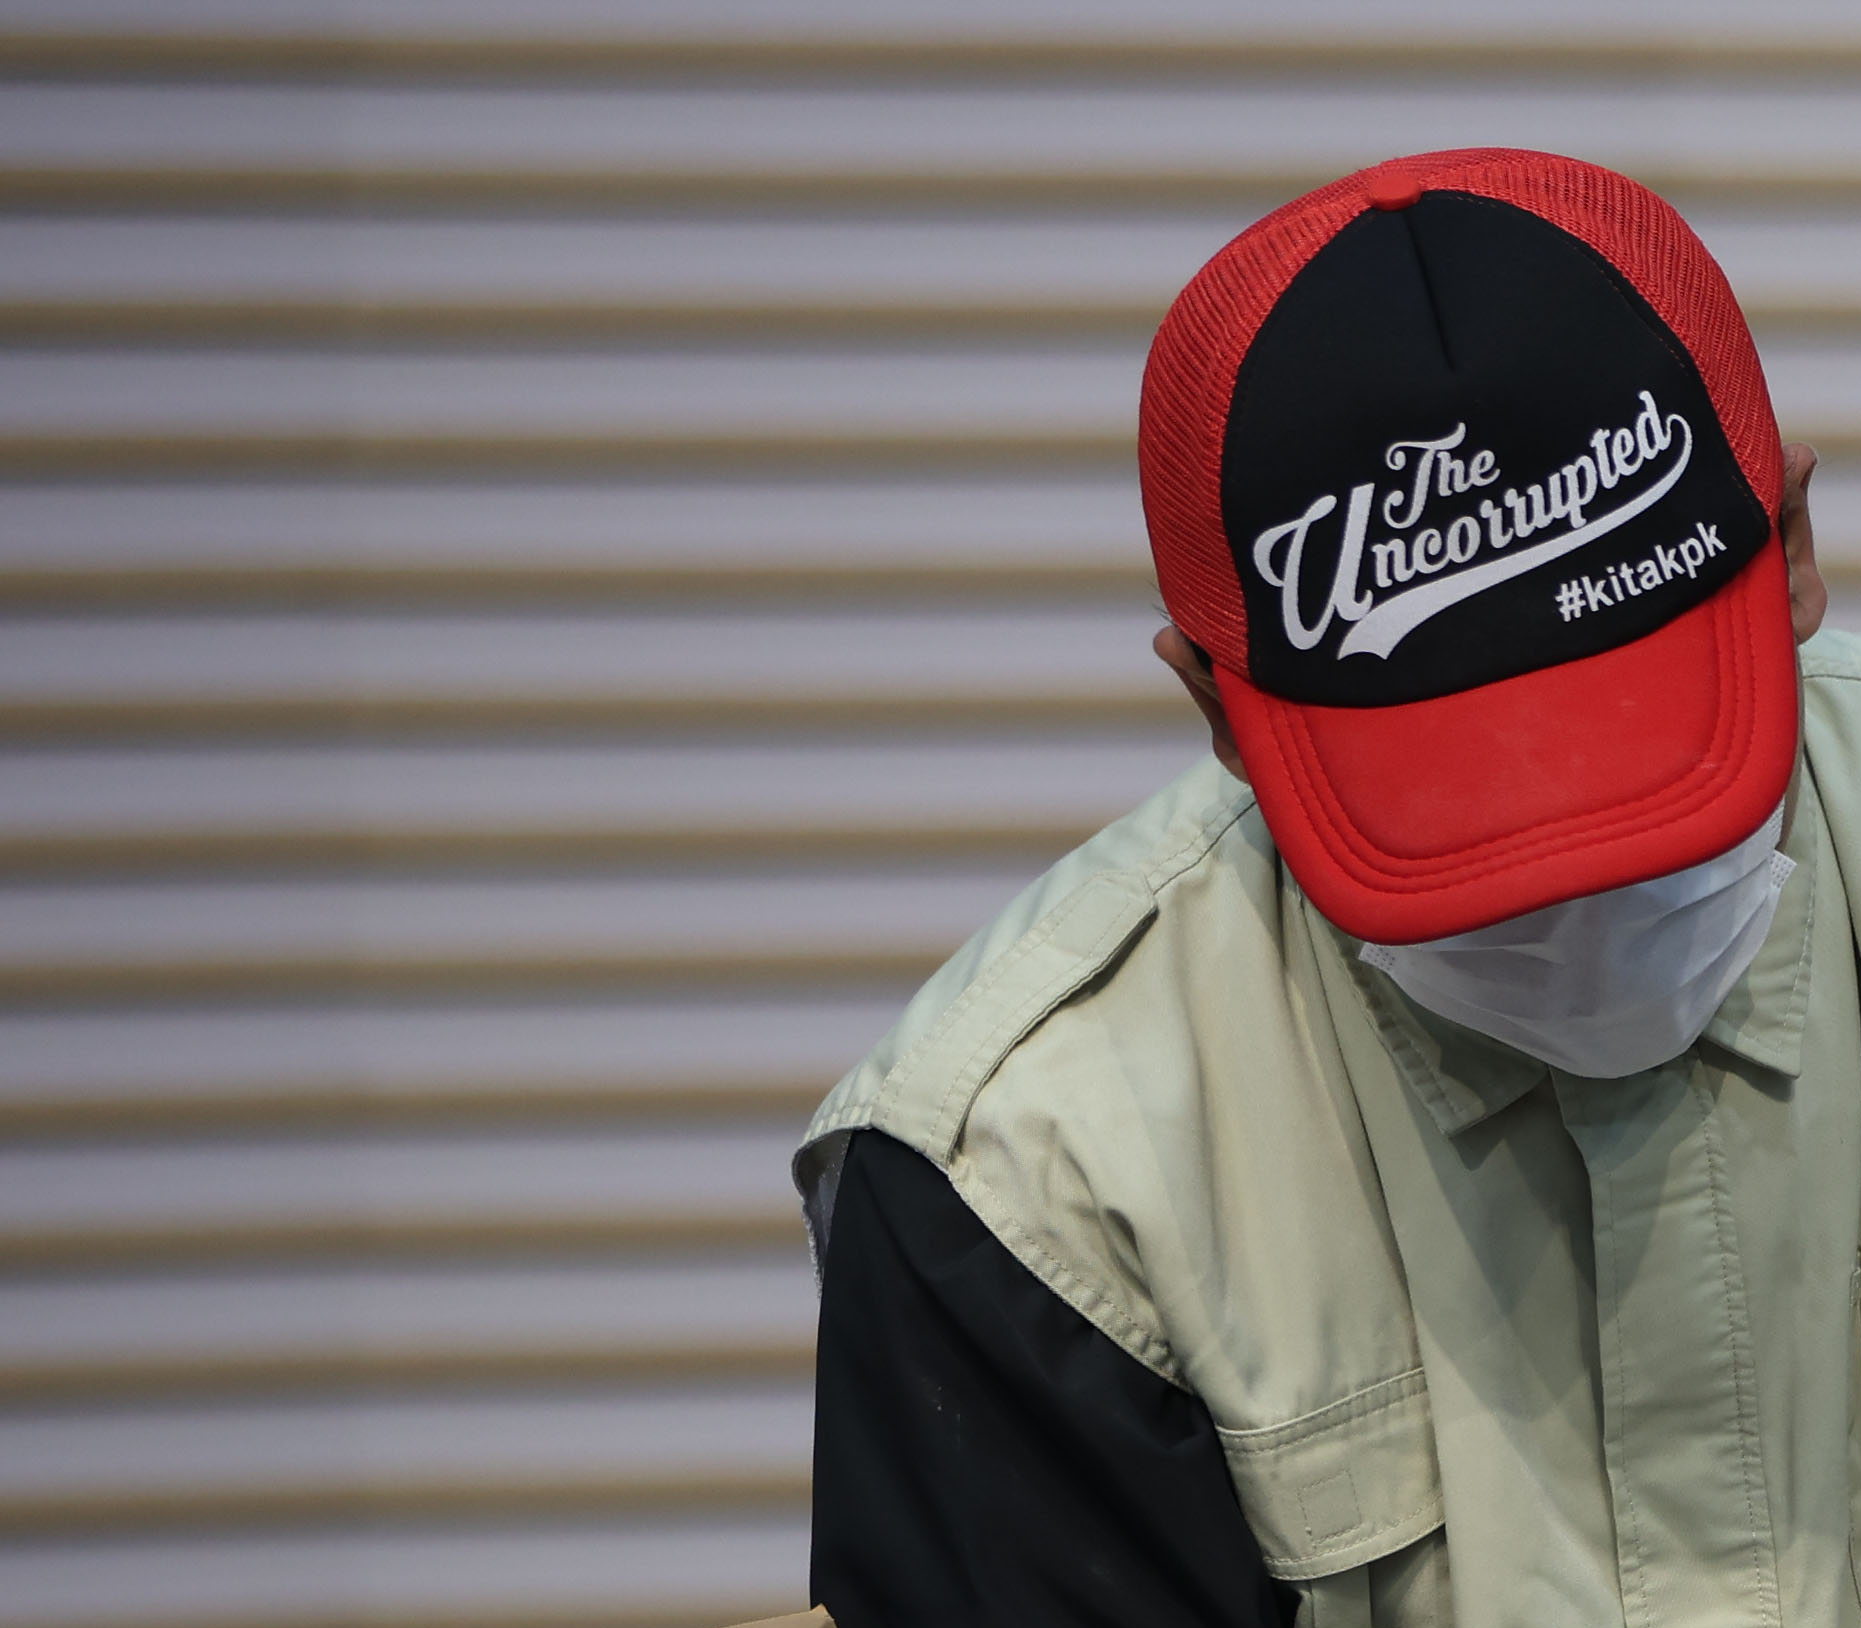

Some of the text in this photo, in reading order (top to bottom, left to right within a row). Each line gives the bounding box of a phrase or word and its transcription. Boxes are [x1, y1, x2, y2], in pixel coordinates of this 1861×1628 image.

[1253, 390, 1692, 660] Uncorrupted
[1383, 421, 1500, 530] The
[1555, 520, 1728, 624] #kitakpk
